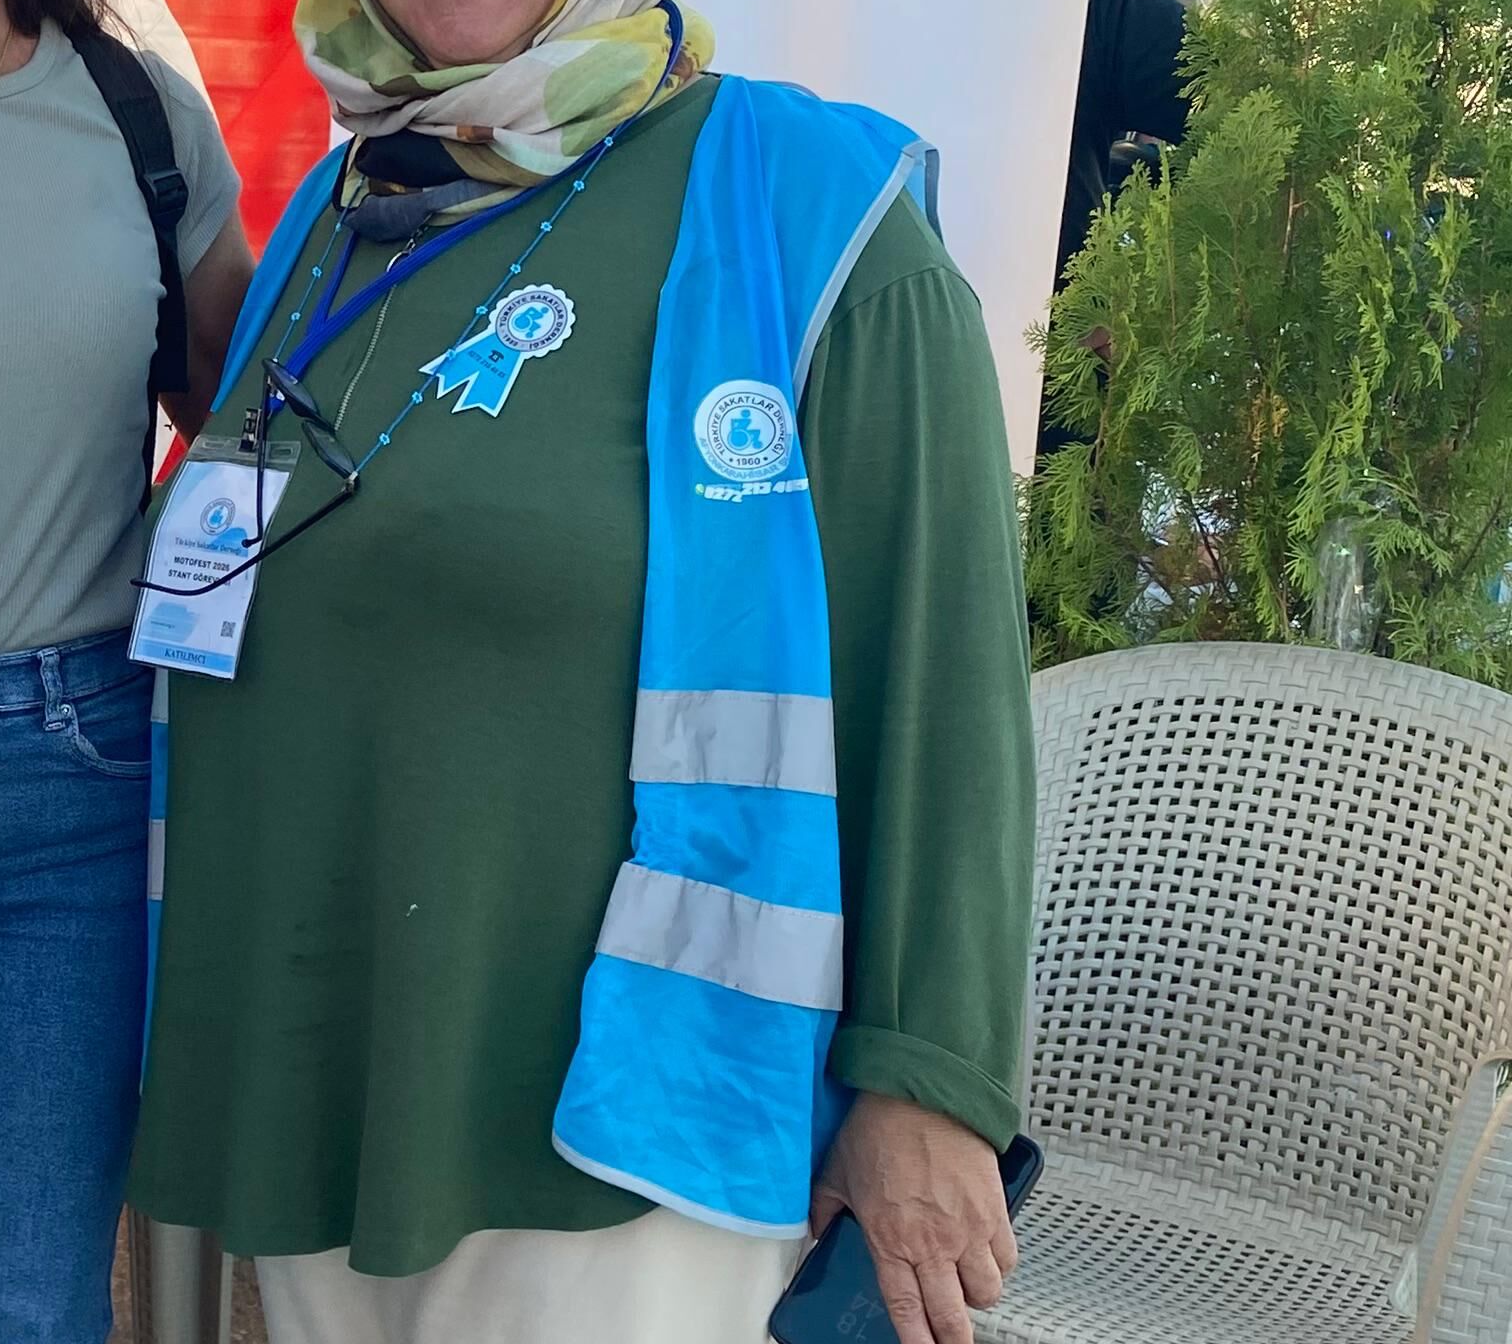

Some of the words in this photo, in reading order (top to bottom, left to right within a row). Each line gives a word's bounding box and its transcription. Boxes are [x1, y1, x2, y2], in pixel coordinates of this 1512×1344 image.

[719, 395, 775, 414] SAKATLAR
[736, 457, 761, 467] 1960
[174, 555, 211, 569] MOTOFEST
[168, 568, 192, 580] STANT
